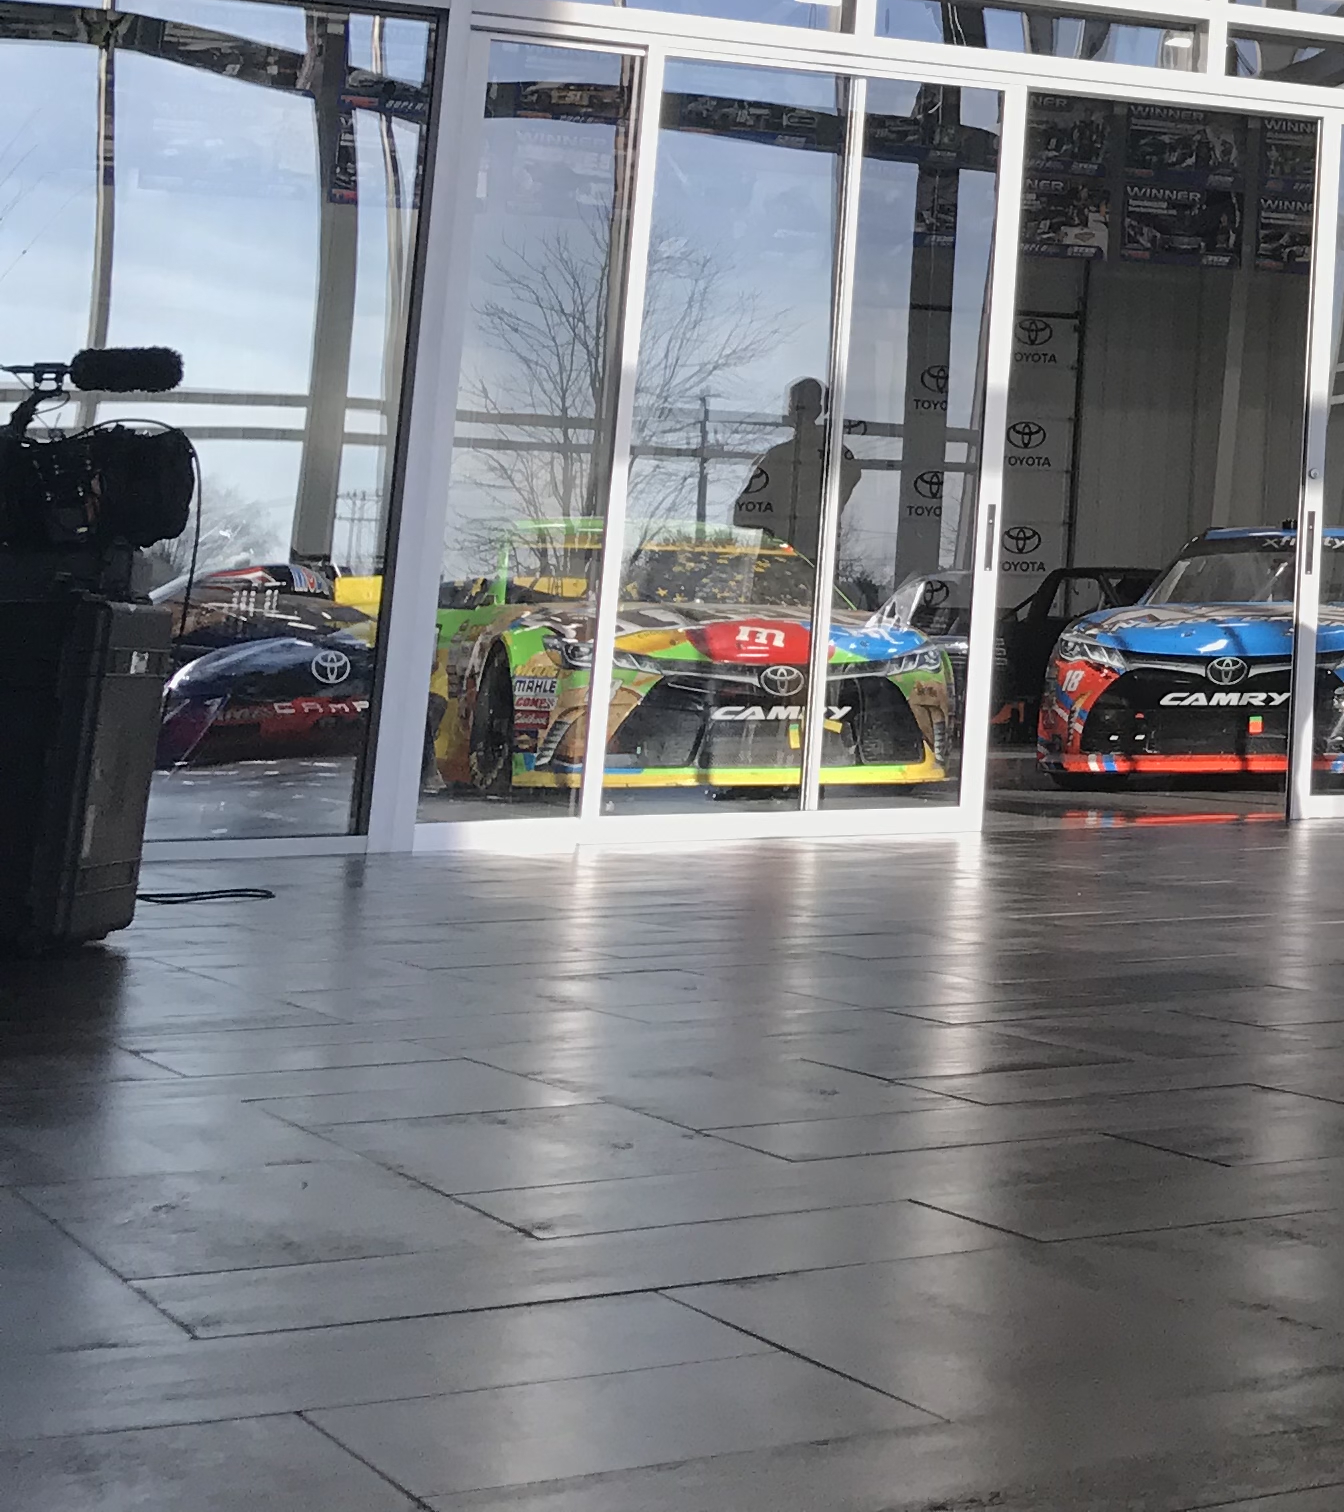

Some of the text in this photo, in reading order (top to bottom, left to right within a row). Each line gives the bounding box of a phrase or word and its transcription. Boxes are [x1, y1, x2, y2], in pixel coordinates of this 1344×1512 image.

[1129, 104, 1205, 122] WINNER
[1265, 118, 1317, 134] WINN
[1126, 184, 1202, 203] WINNER
[1260, 197, 1312, 213] WINN
[913, 399, 948, 410] TOYO
[515, 678, 557, 694] MAHLE
[1062, 670, 1085, 692] 18
[1159, 692, 1292, 707] CAMRY
